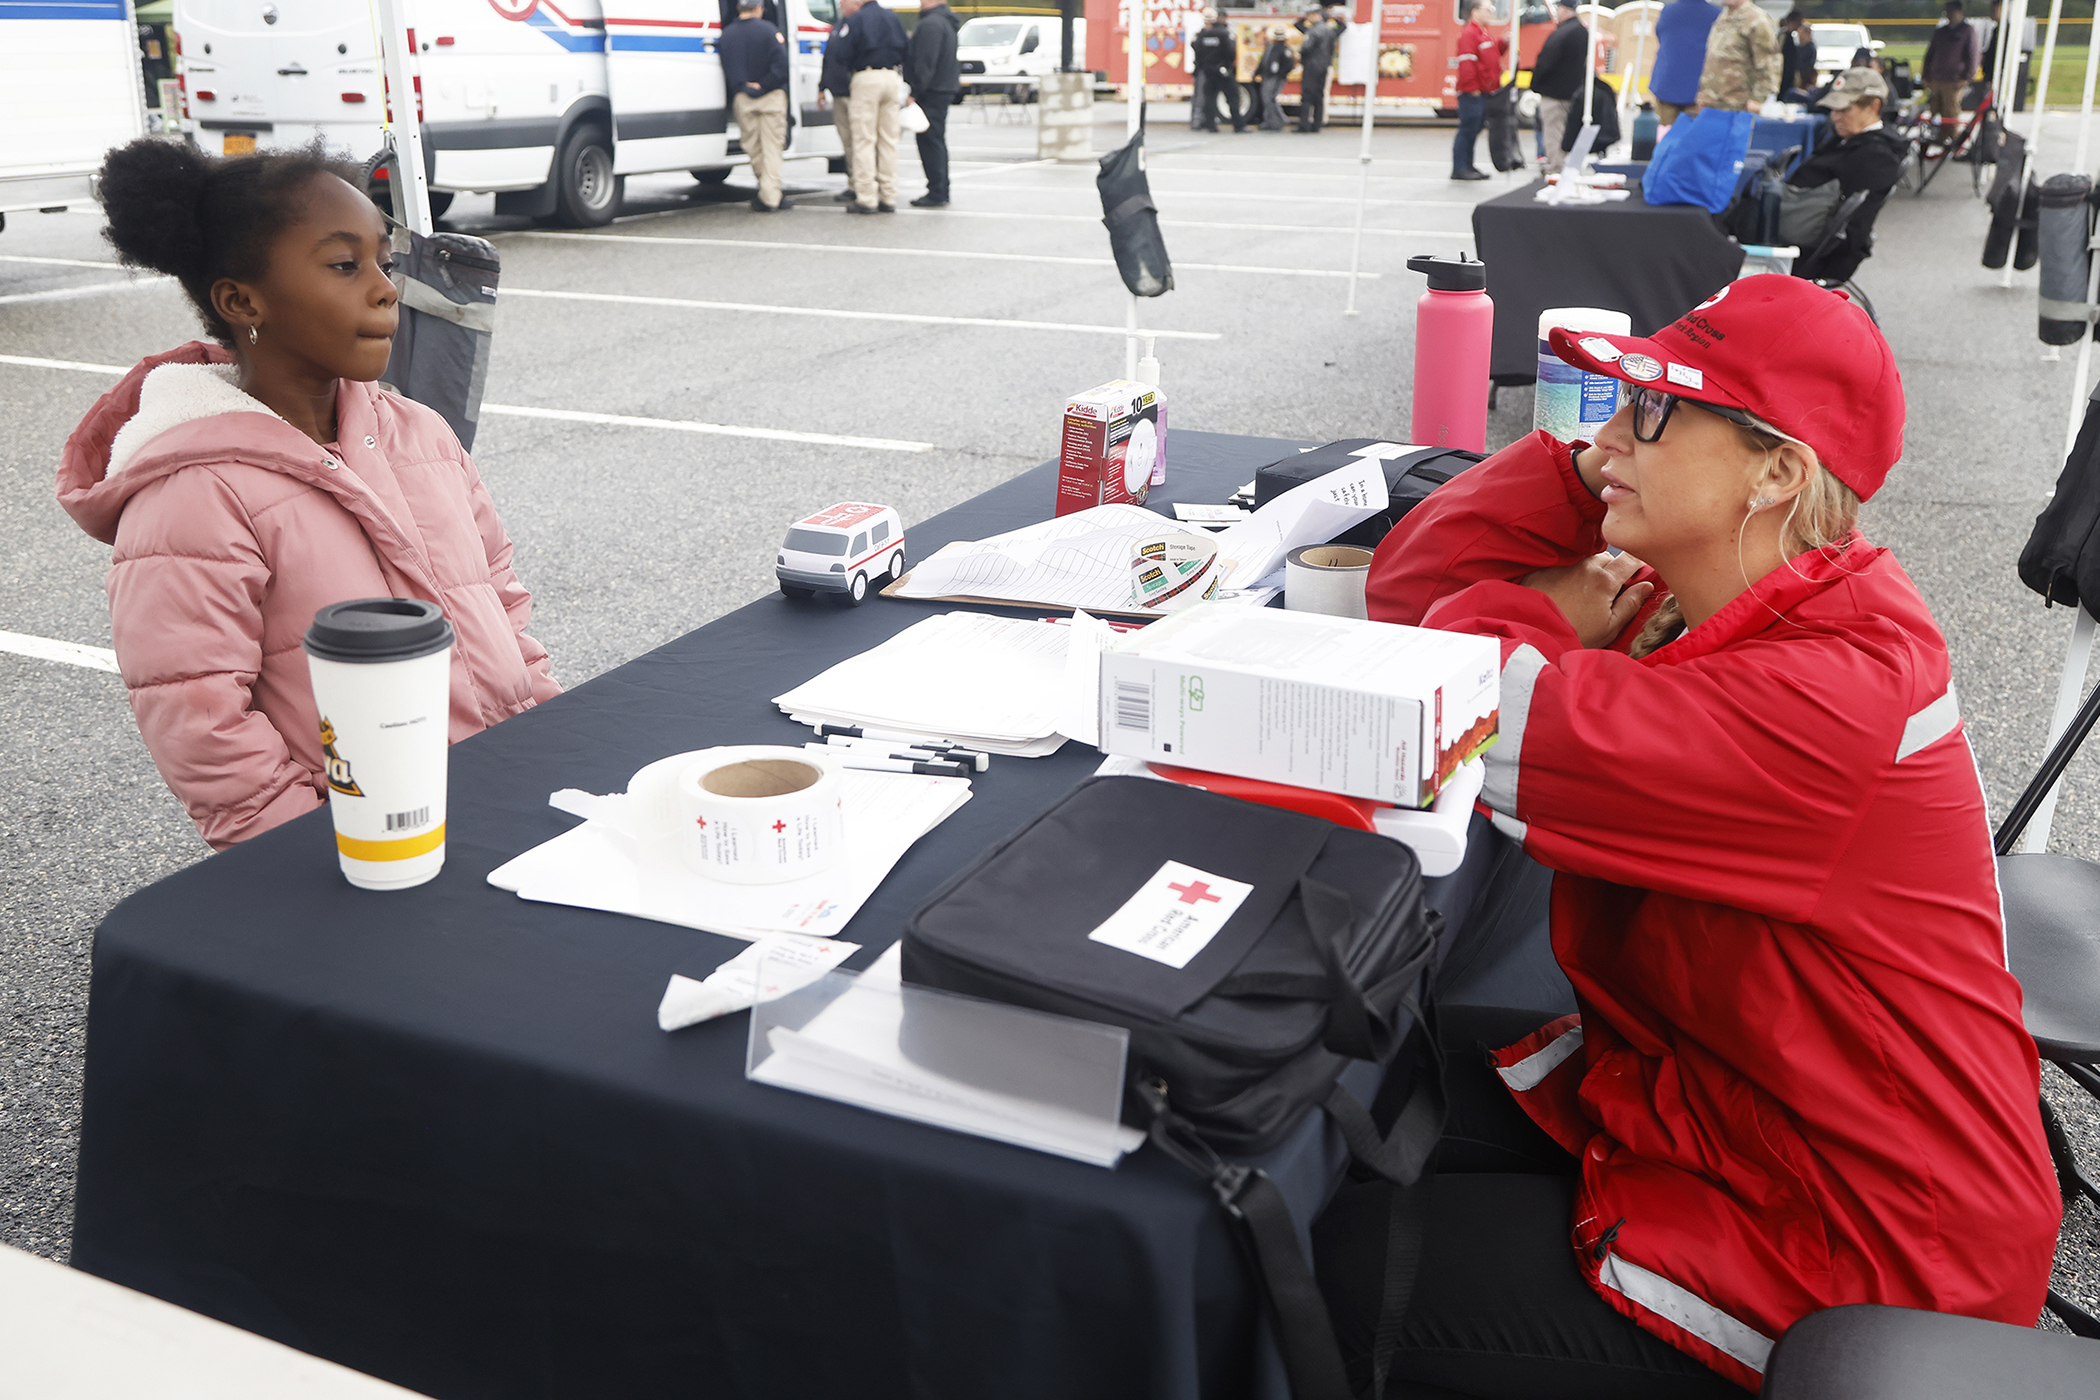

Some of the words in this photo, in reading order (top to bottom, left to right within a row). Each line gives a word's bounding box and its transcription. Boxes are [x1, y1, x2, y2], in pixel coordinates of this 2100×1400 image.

[1684, 327, 1711, 349] Region
[1696, 317, 1726, 341] Cross
[1075, 403, 1098, 415] Kidde
[1131, 395, 1143, 415] 10
[1143, 394, 1154, 404] YEAR
[1142, 543, 1165, 555] Scotch
[1140, 569, 1162, 583] Scotch
[1160, 908, 1184, 925] Red
[1156, 914, 1198, 950] American
